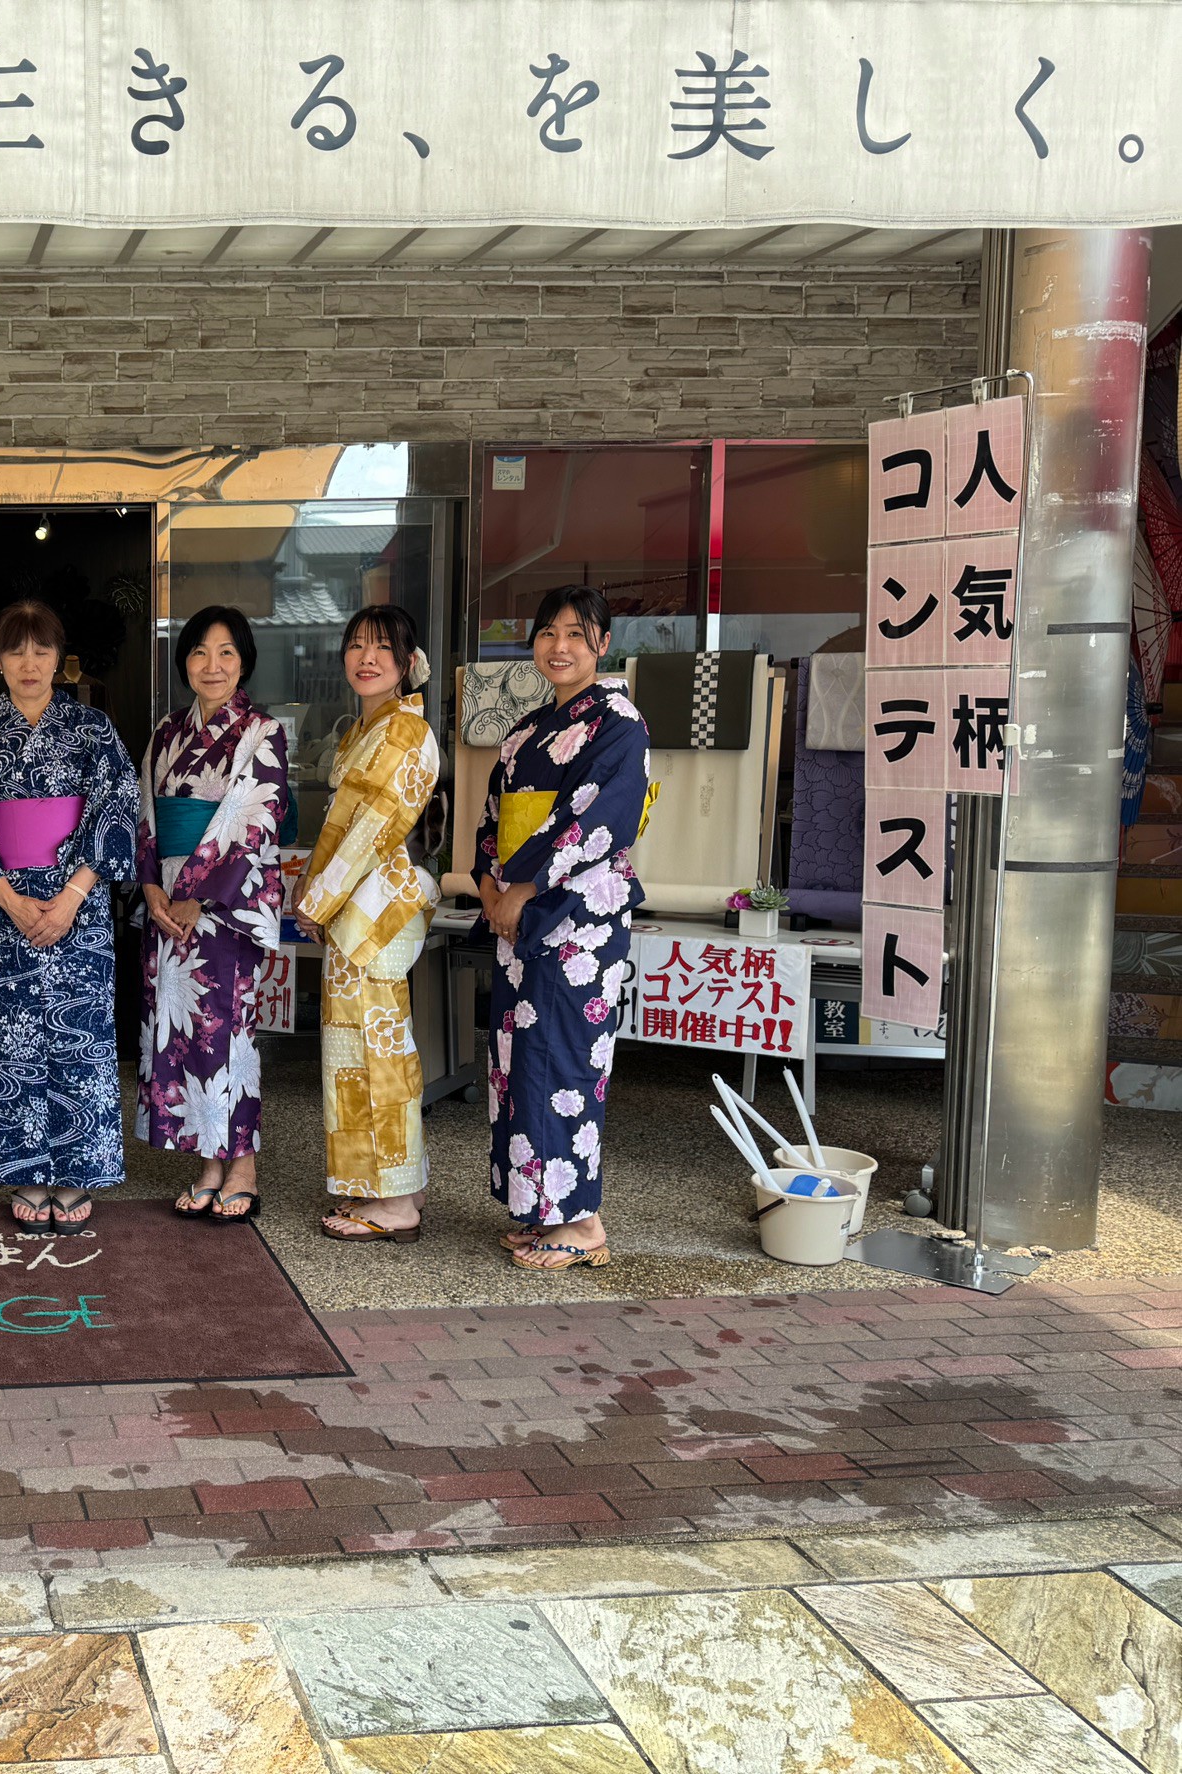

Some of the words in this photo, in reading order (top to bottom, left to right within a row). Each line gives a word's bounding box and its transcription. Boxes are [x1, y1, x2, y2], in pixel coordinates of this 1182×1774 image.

[951, 430, 1017, 770] 人気柄
[874, 448, 939, 997] コンテスト
[657, 940, 777, 980] 人気柄
[642, 972, 796, 1015] コンテスト
[642, 1006, 793, 1053] 開催中!!
[823, 1000, 846, 1038] 教室
